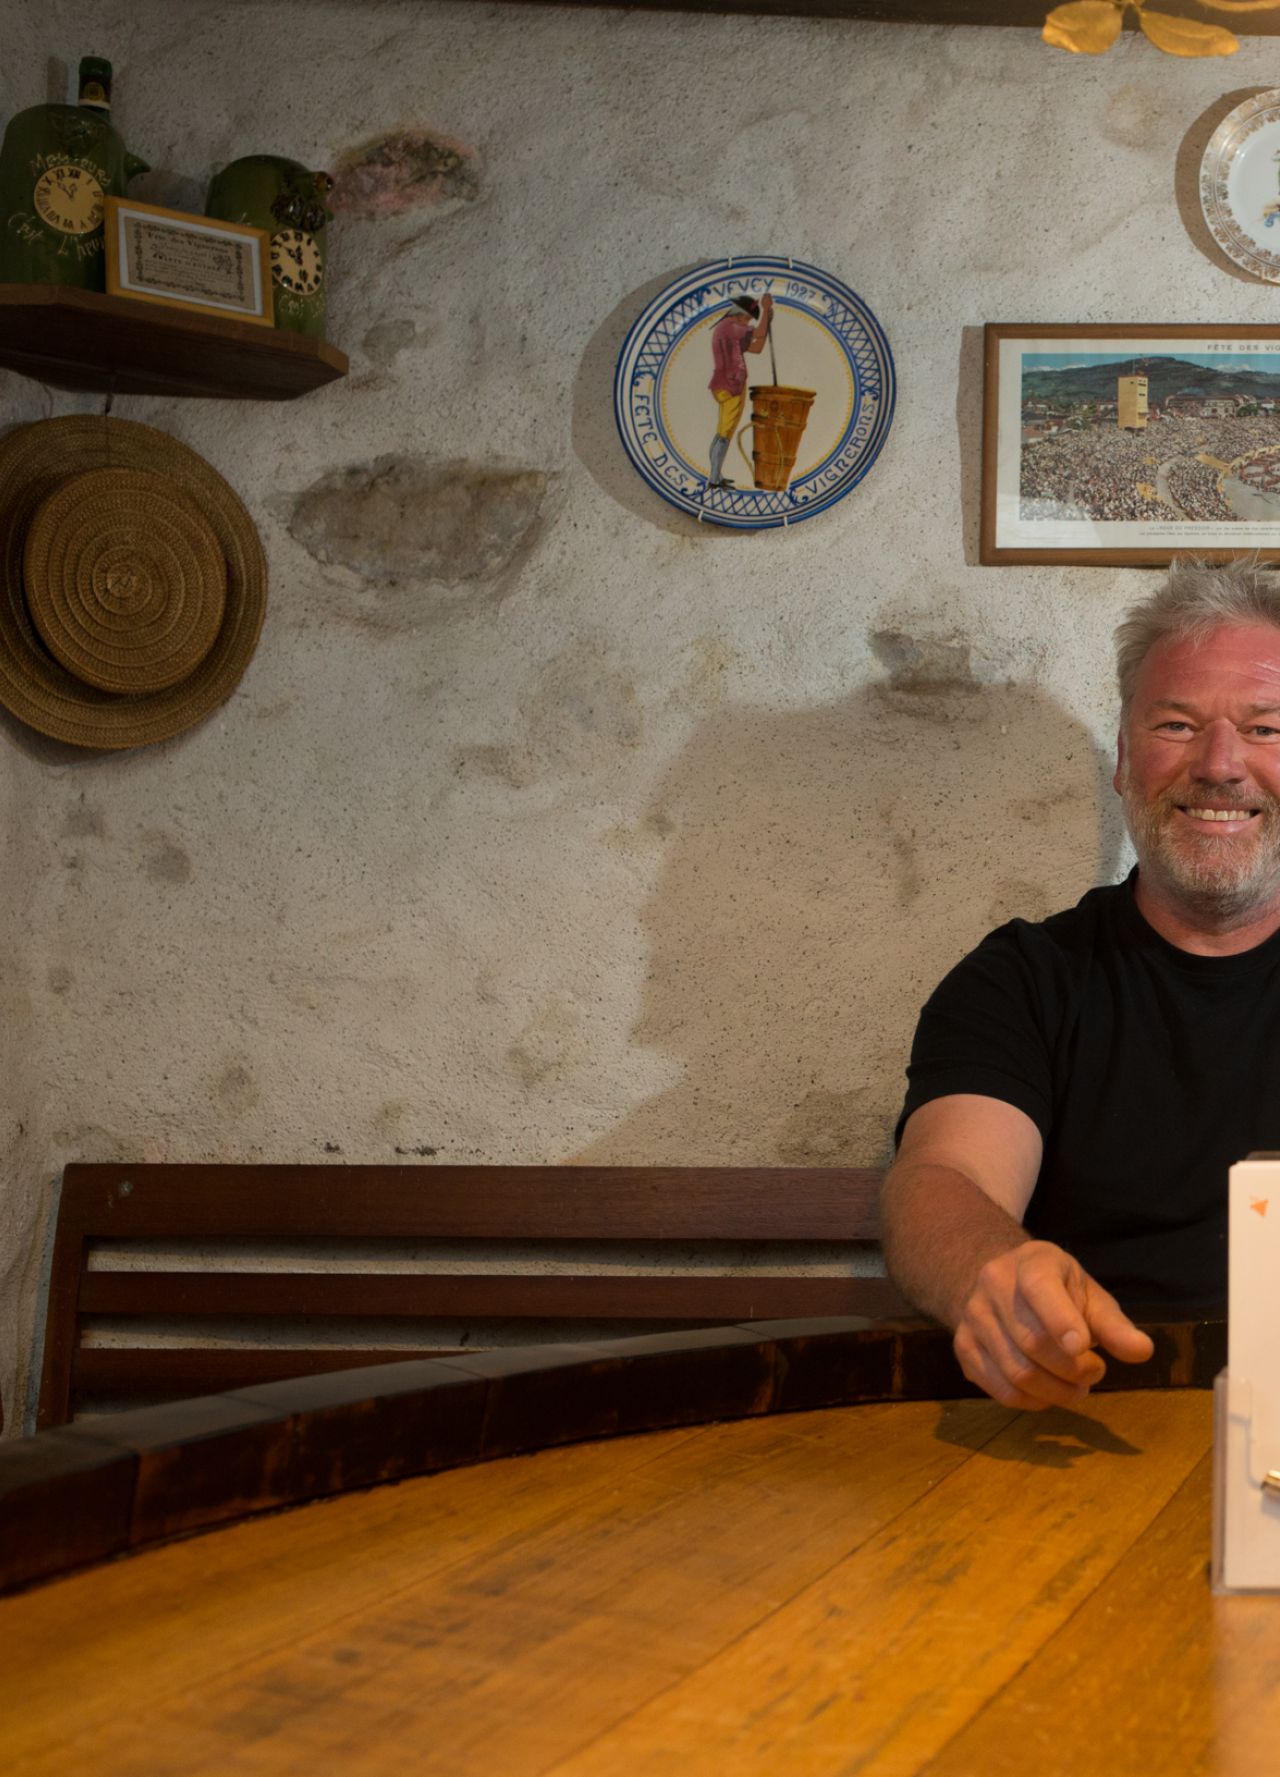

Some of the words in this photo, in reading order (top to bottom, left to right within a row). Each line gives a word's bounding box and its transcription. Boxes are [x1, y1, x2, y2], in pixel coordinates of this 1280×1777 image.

[1207, 343, 1233, 351] FÊTE
[634, 394, 659, 446] FETE
[653, 452, 688, 487] DES
[805, 403, 876, 494] VIGNERONS
